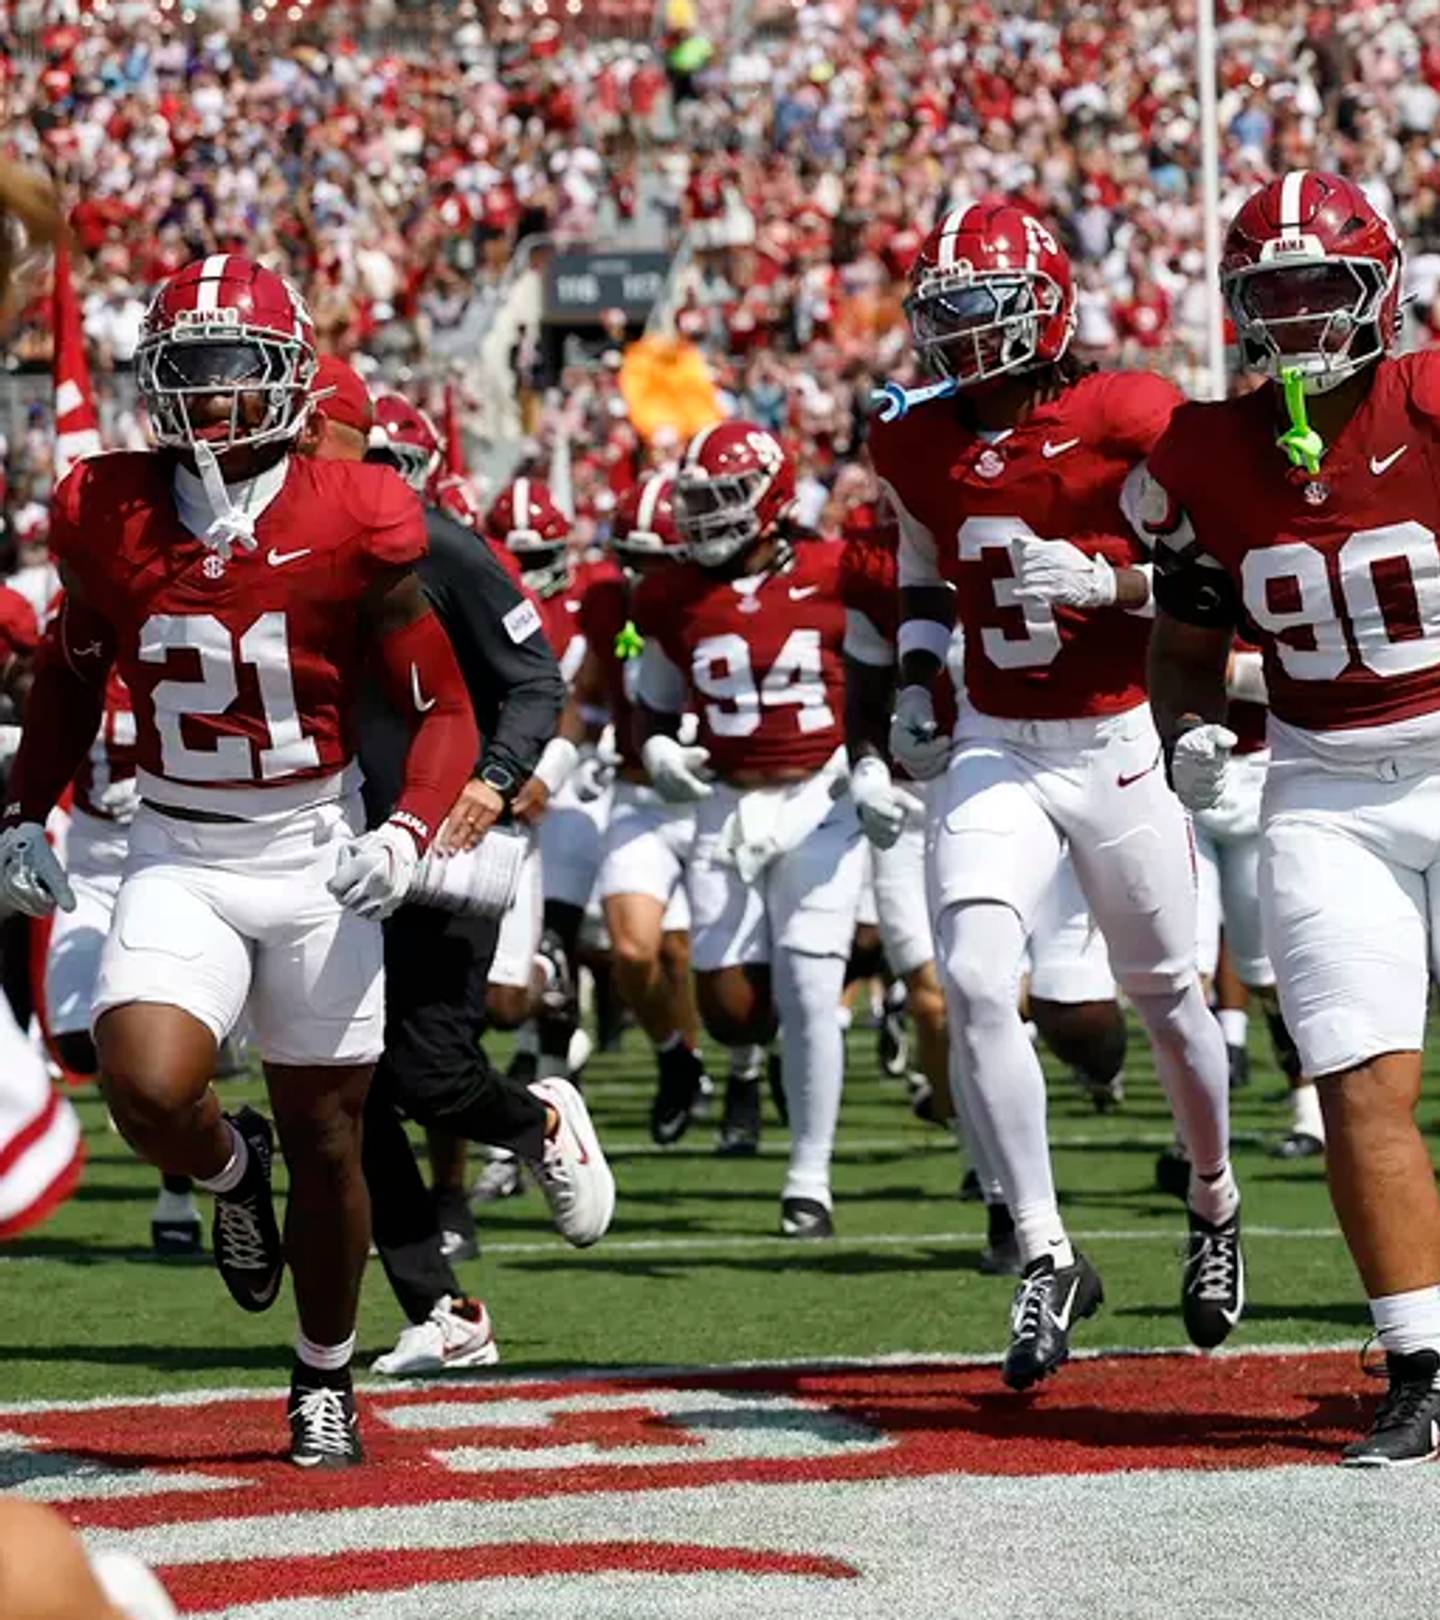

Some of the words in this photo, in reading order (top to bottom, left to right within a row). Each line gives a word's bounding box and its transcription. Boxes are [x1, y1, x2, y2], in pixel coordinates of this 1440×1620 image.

[1273, 238, 1306, 252] BAMA
[958, 515, 1063, 669] 3
[138, 611, 320, 781] 21
[692, 628, 835, 736] 94
